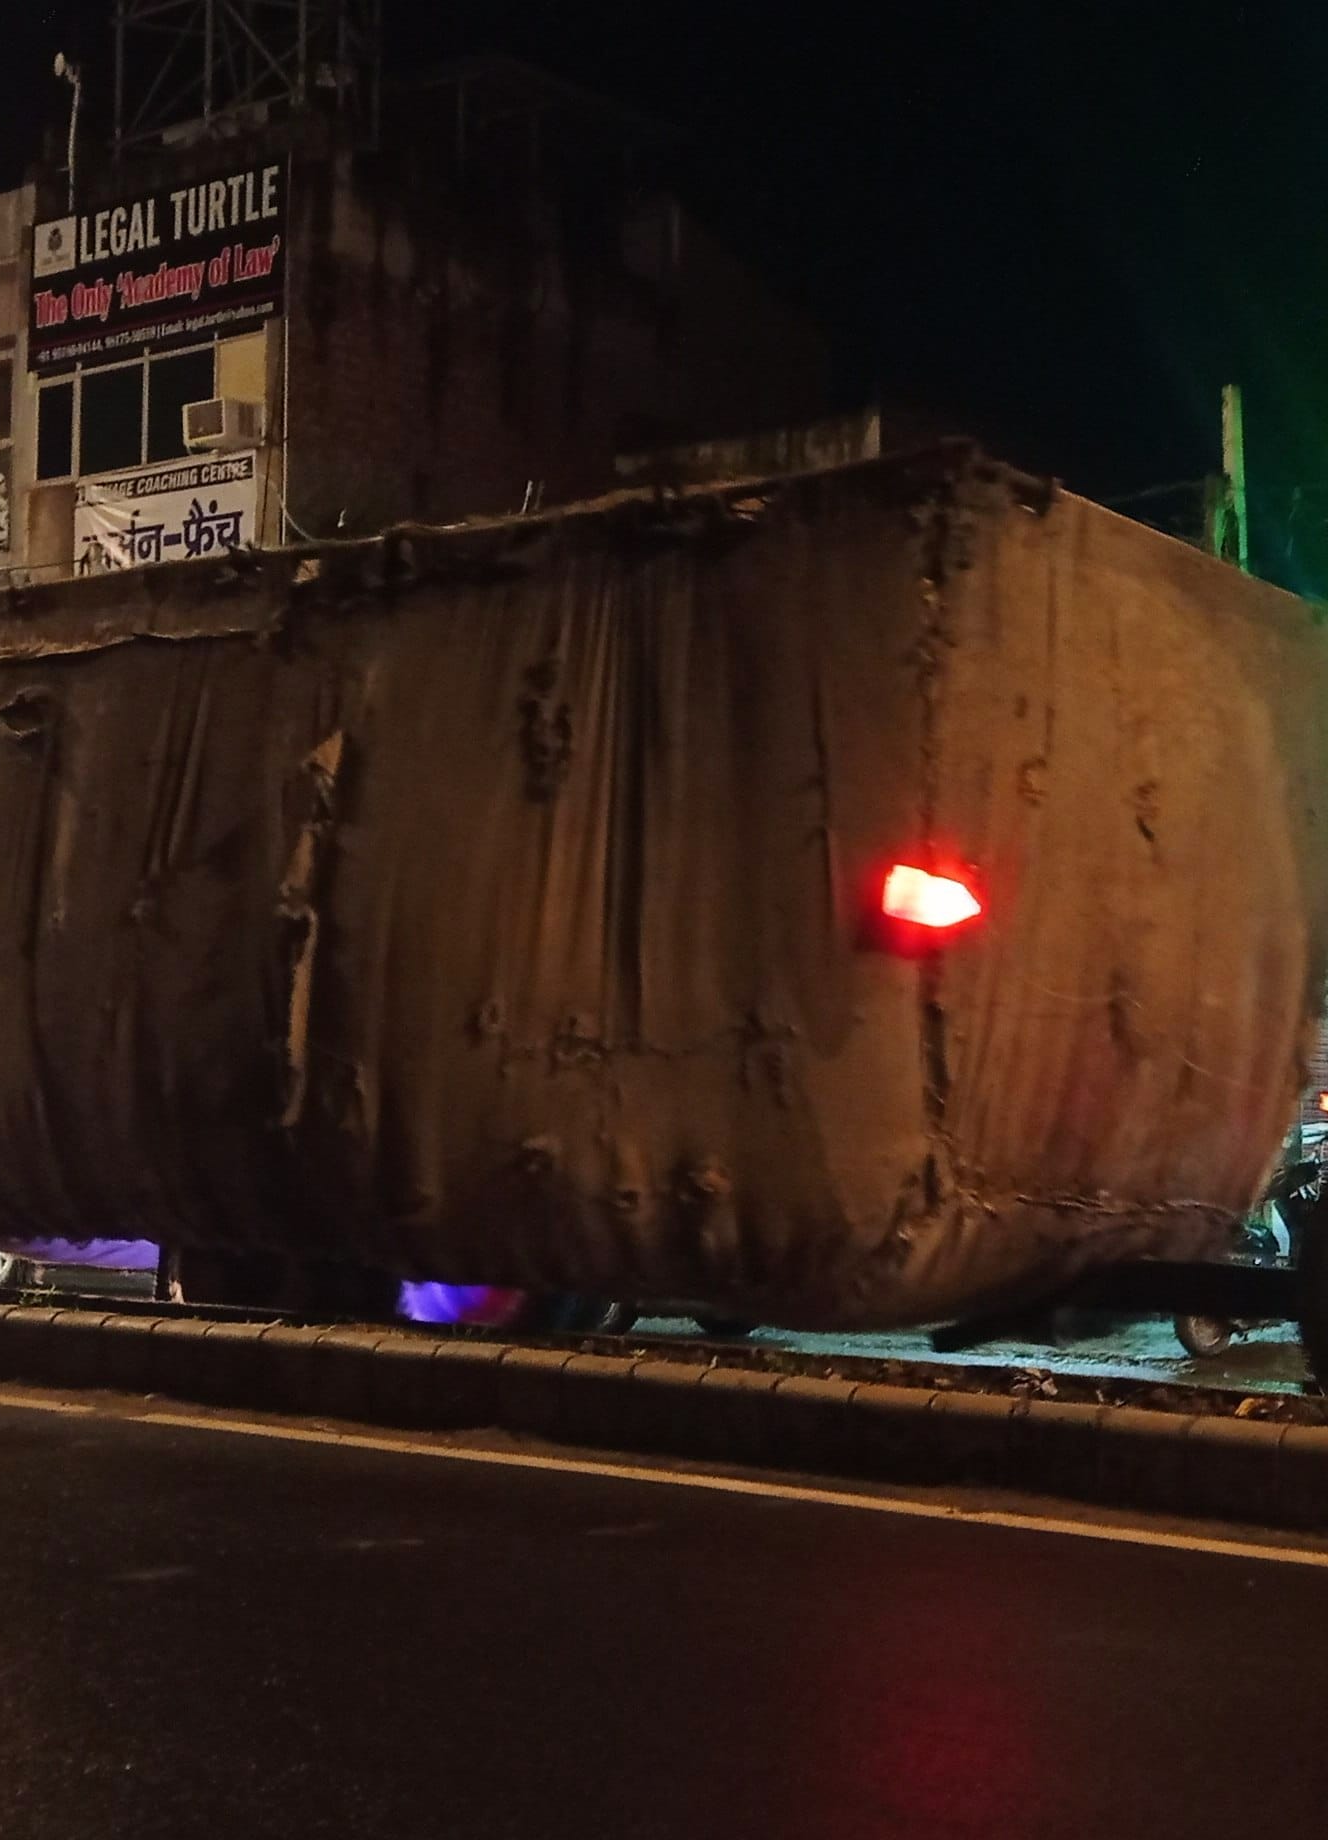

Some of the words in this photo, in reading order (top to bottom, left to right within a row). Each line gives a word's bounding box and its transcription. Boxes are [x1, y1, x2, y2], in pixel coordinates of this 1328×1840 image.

[80, 198, 161, 265] LEGAL
[170, 165, 279, 240] TURTLE
[35, 290, 68, 328] The
[71, 279, 113, 322] Only
[208, 247, 230, 287] of
[136, 468, 198, 495] COACHING
[200, 457, 250, 483] CENTRE
